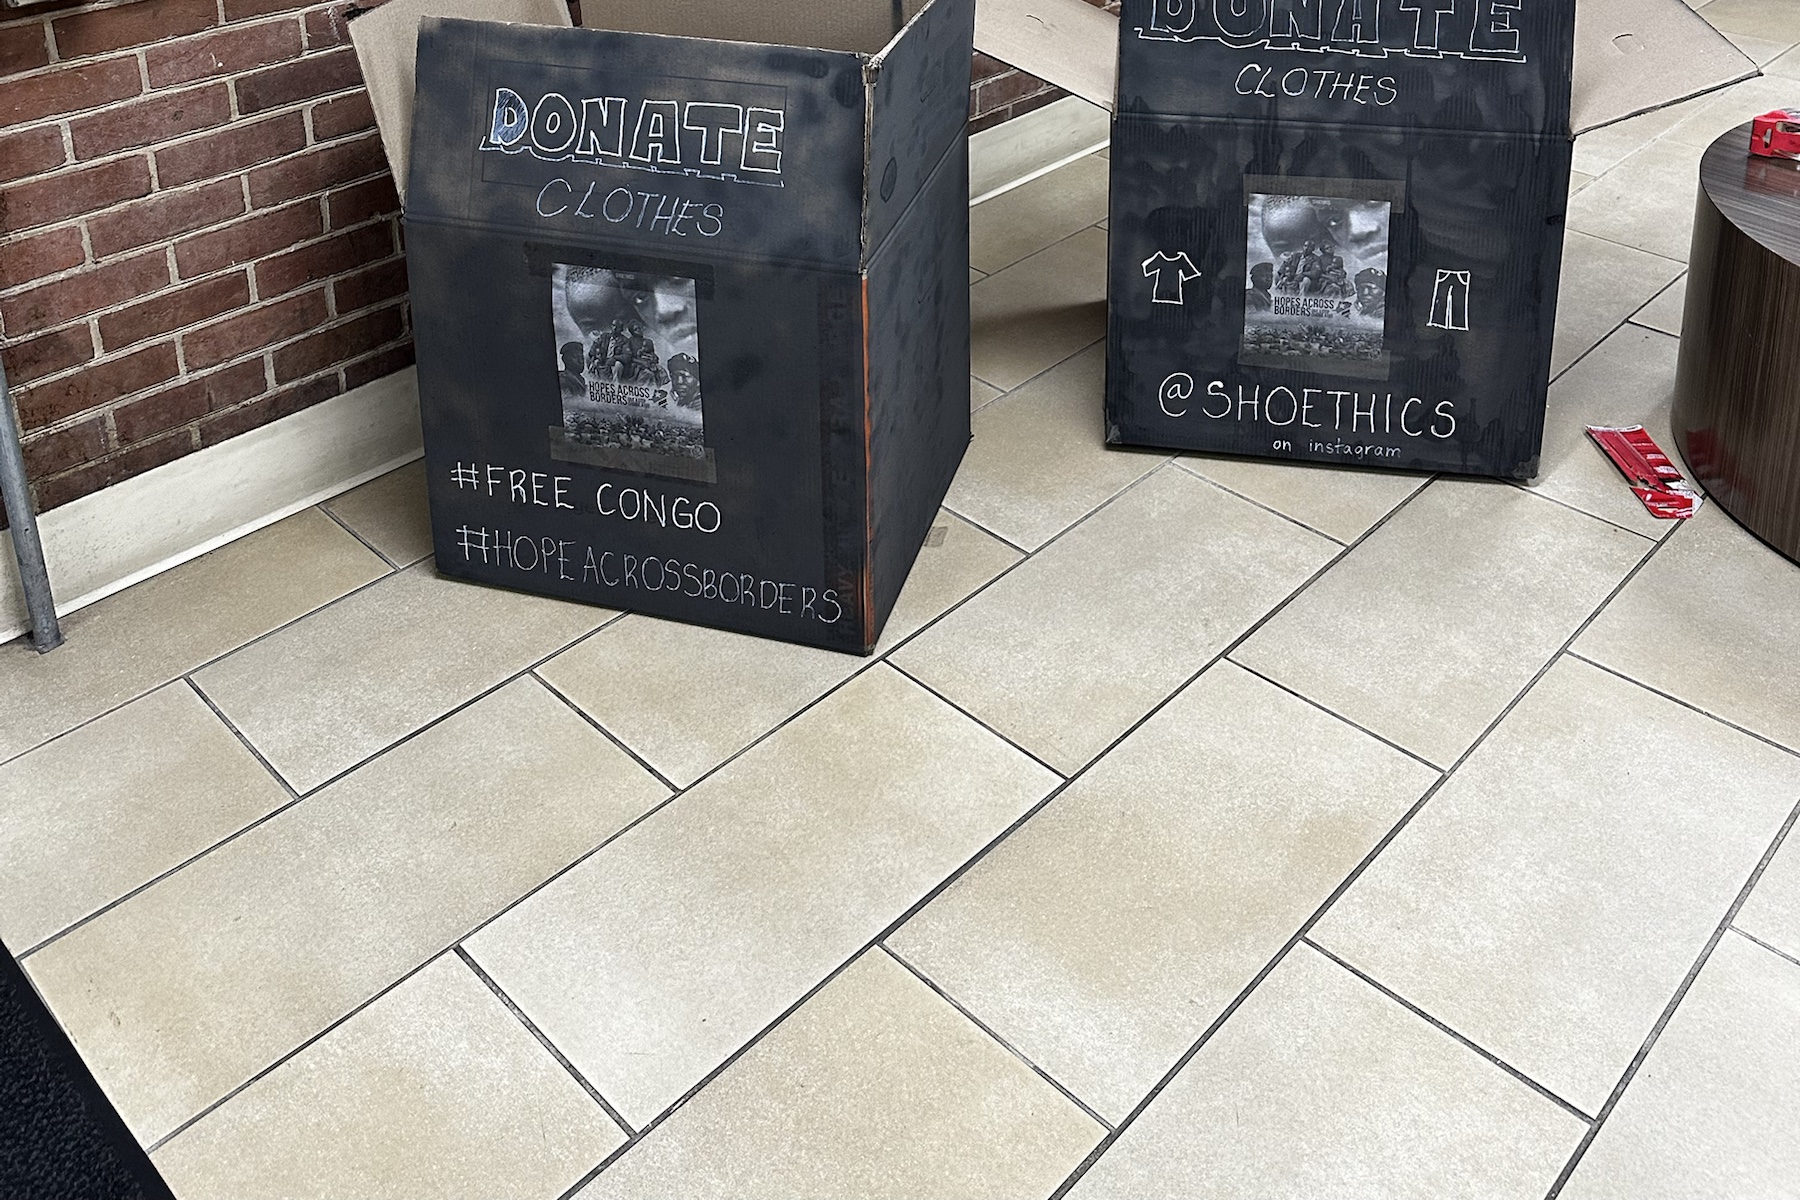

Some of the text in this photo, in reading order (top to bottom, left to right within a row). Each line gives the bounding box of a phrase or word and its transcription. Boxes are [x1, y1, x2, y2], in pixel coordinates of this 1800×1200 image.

[1235, 63, 1397, 106] CLOTHES
[488, 87, 785, 174] DONATE
[536, 177, 723, 237] CLOTHES
[1275, 296, 1334, 309] HOPES ACROSS
[1275, 306, 1310, 316] BORDERS
[589, 381, 649, 398] HOPES ACROSS
[590, 392, 627, 405] BORDERS
[1159, 371, 1456, 438] @SHOETHICS
[1273, 438, 1401, 460] on instagram
[450, 462, 723, 534] #FREE CONGO
